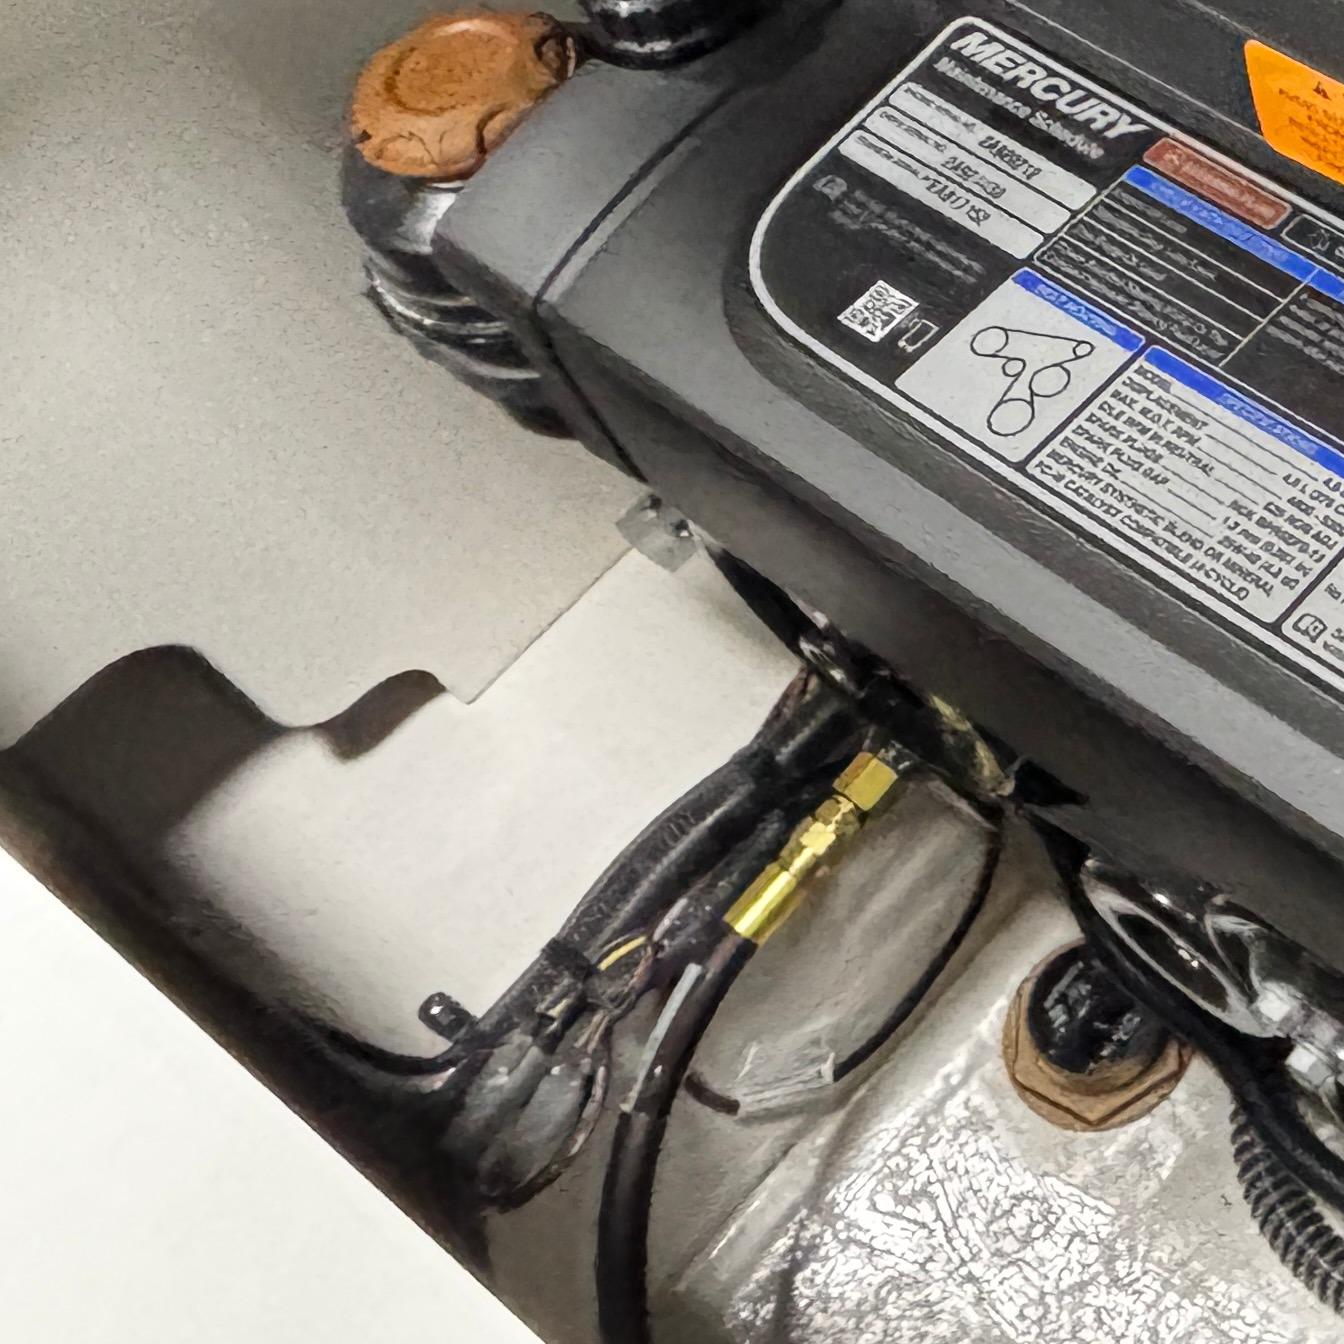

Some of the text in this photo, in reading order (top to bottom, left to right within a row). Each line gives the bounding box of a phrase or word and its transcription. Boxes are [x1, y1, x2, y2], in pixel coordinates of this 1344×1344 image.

[931, 56, 1033, 117] Maintenance
[1027, 111, 1107, 158] Schedule
[947, 31, 1151, 139] MERCURY
